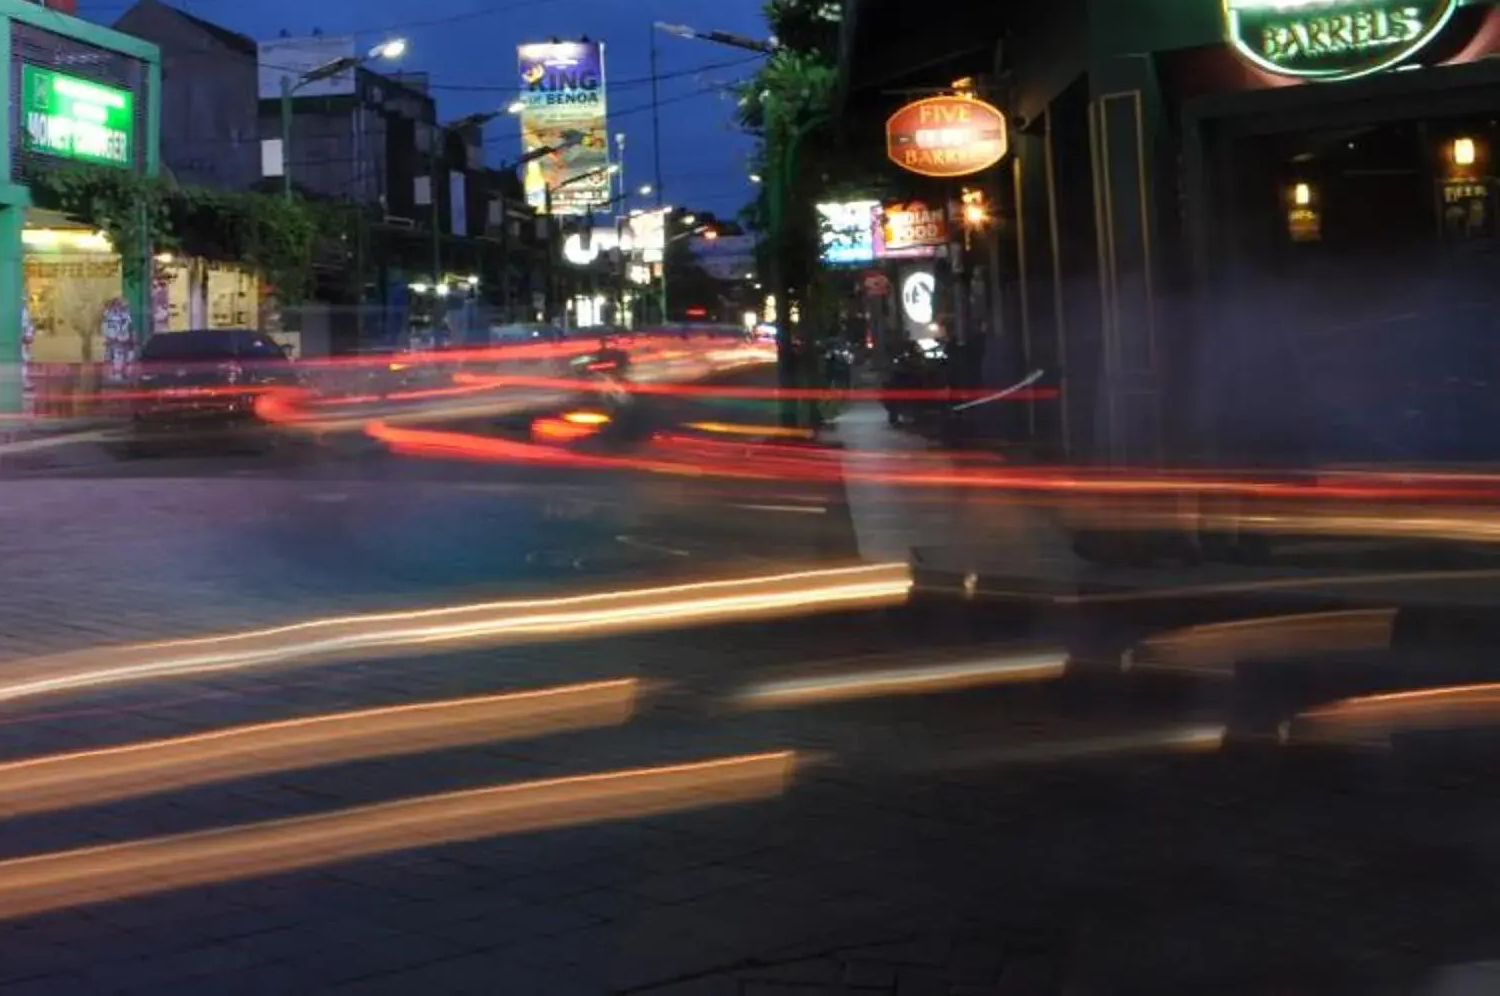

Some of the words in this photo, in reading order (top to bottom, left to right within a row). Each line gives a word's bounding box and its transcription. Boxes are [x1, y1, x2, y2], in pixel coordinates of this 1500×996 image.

[1263, 6, 1423, 62] BARRELS
[546, 92, 598, 105] BENOA
[919, 104, 967, 124] FIVE
[904, 148, 991, 166] BARR
[895, 224, 939, 239] OOD
